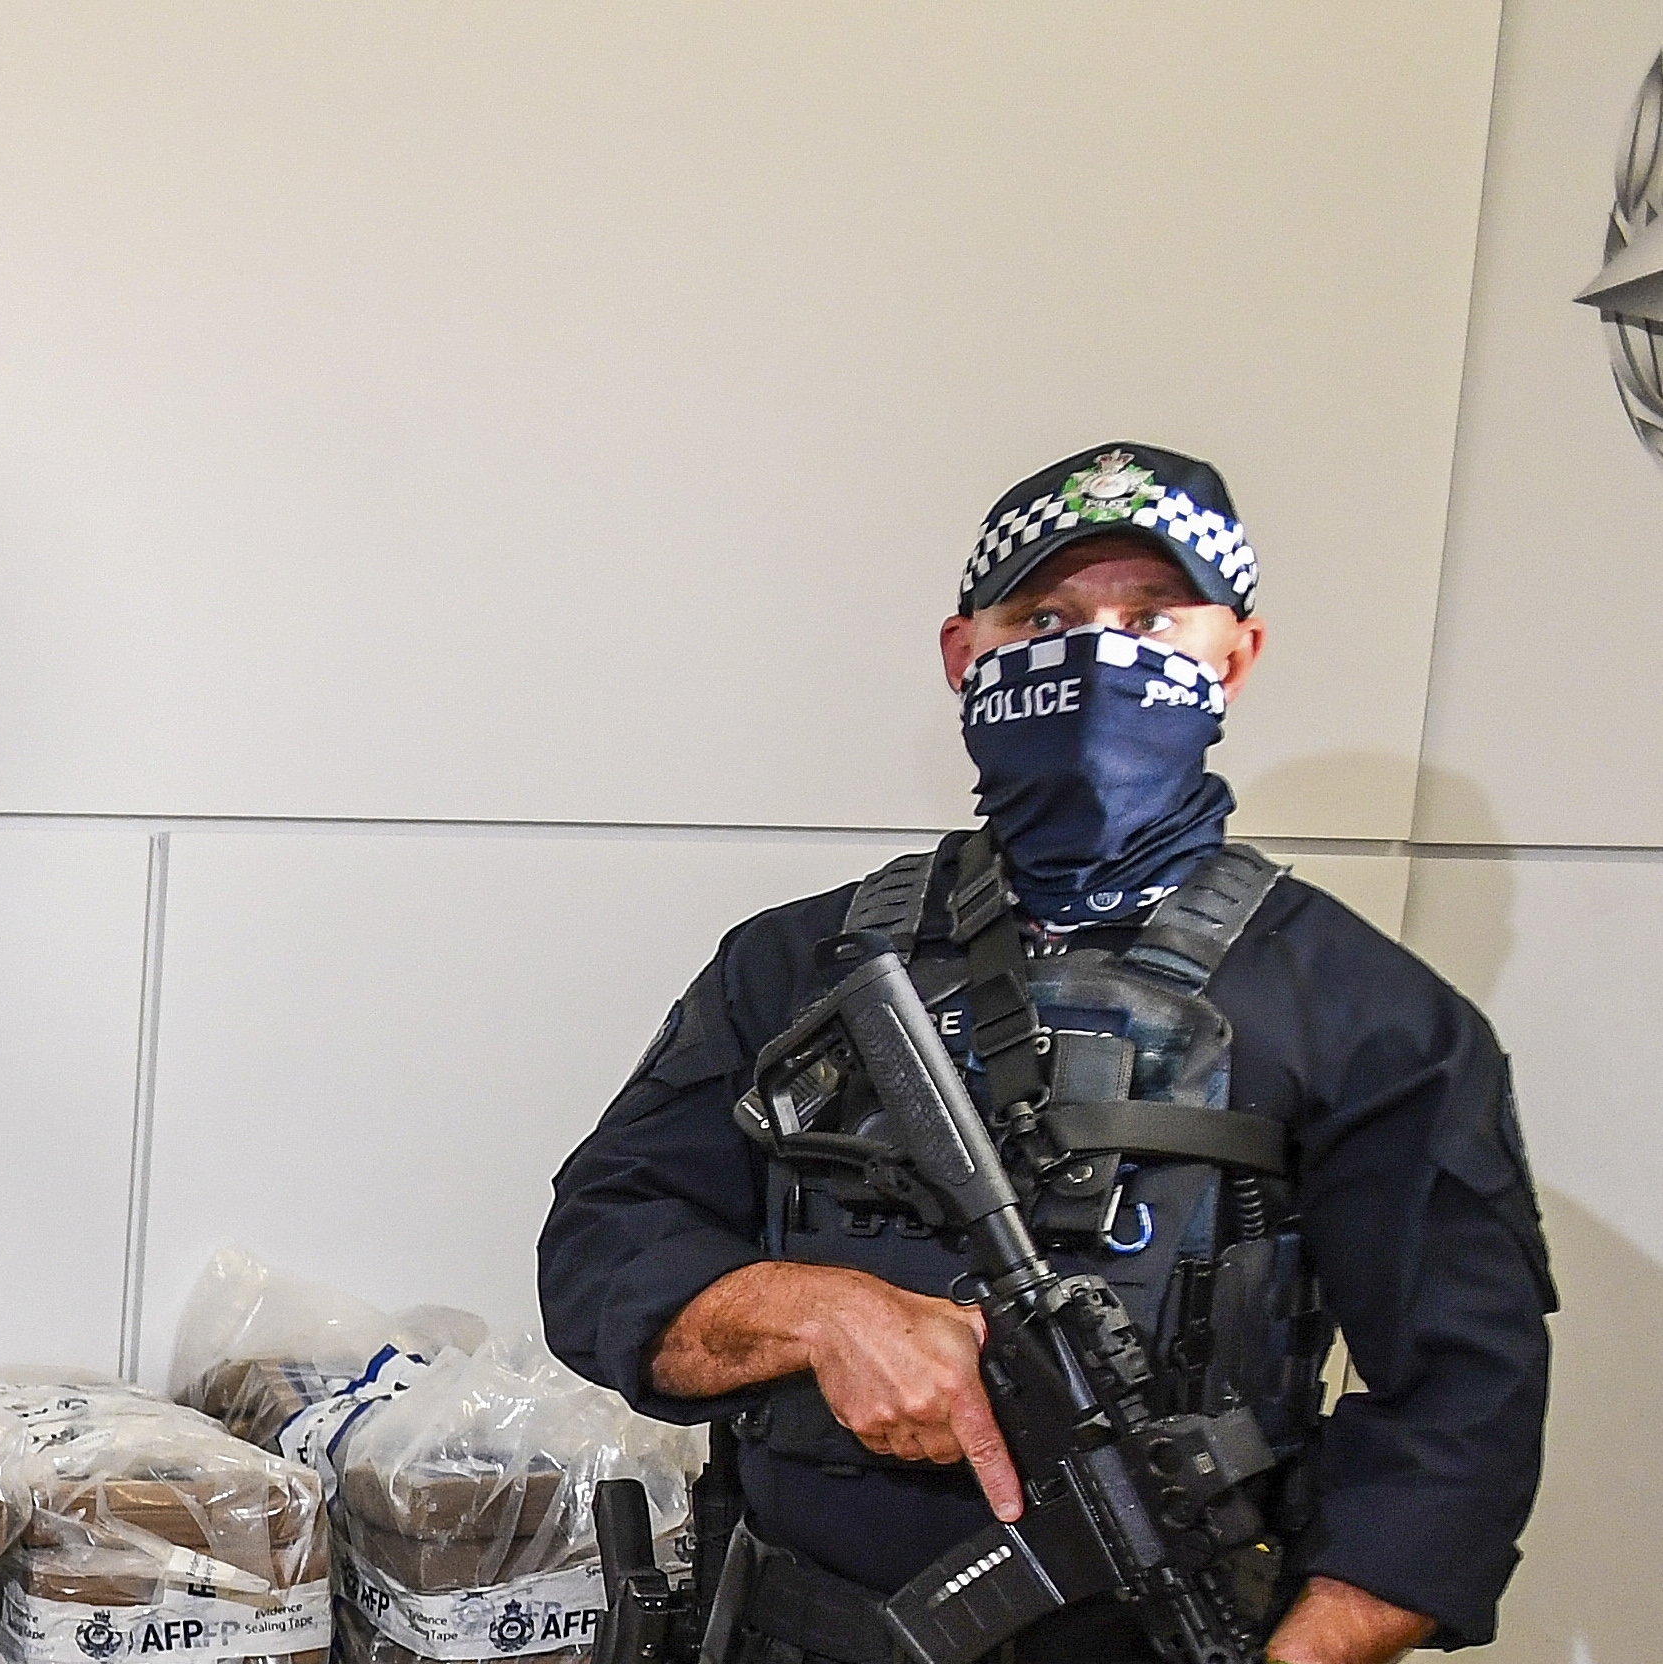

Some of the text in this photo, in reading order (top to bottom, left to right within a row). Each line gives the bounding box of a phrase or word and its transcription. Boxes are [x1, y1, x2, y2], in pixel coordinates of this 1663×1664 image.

[970, 677, 1082, 727] POLICE
[254, 1601, 303, 1620] Evidence
[540, 1609, 599, 1641] AFP
[140, 1615, 315, 1654] AFP Sealing Tape
